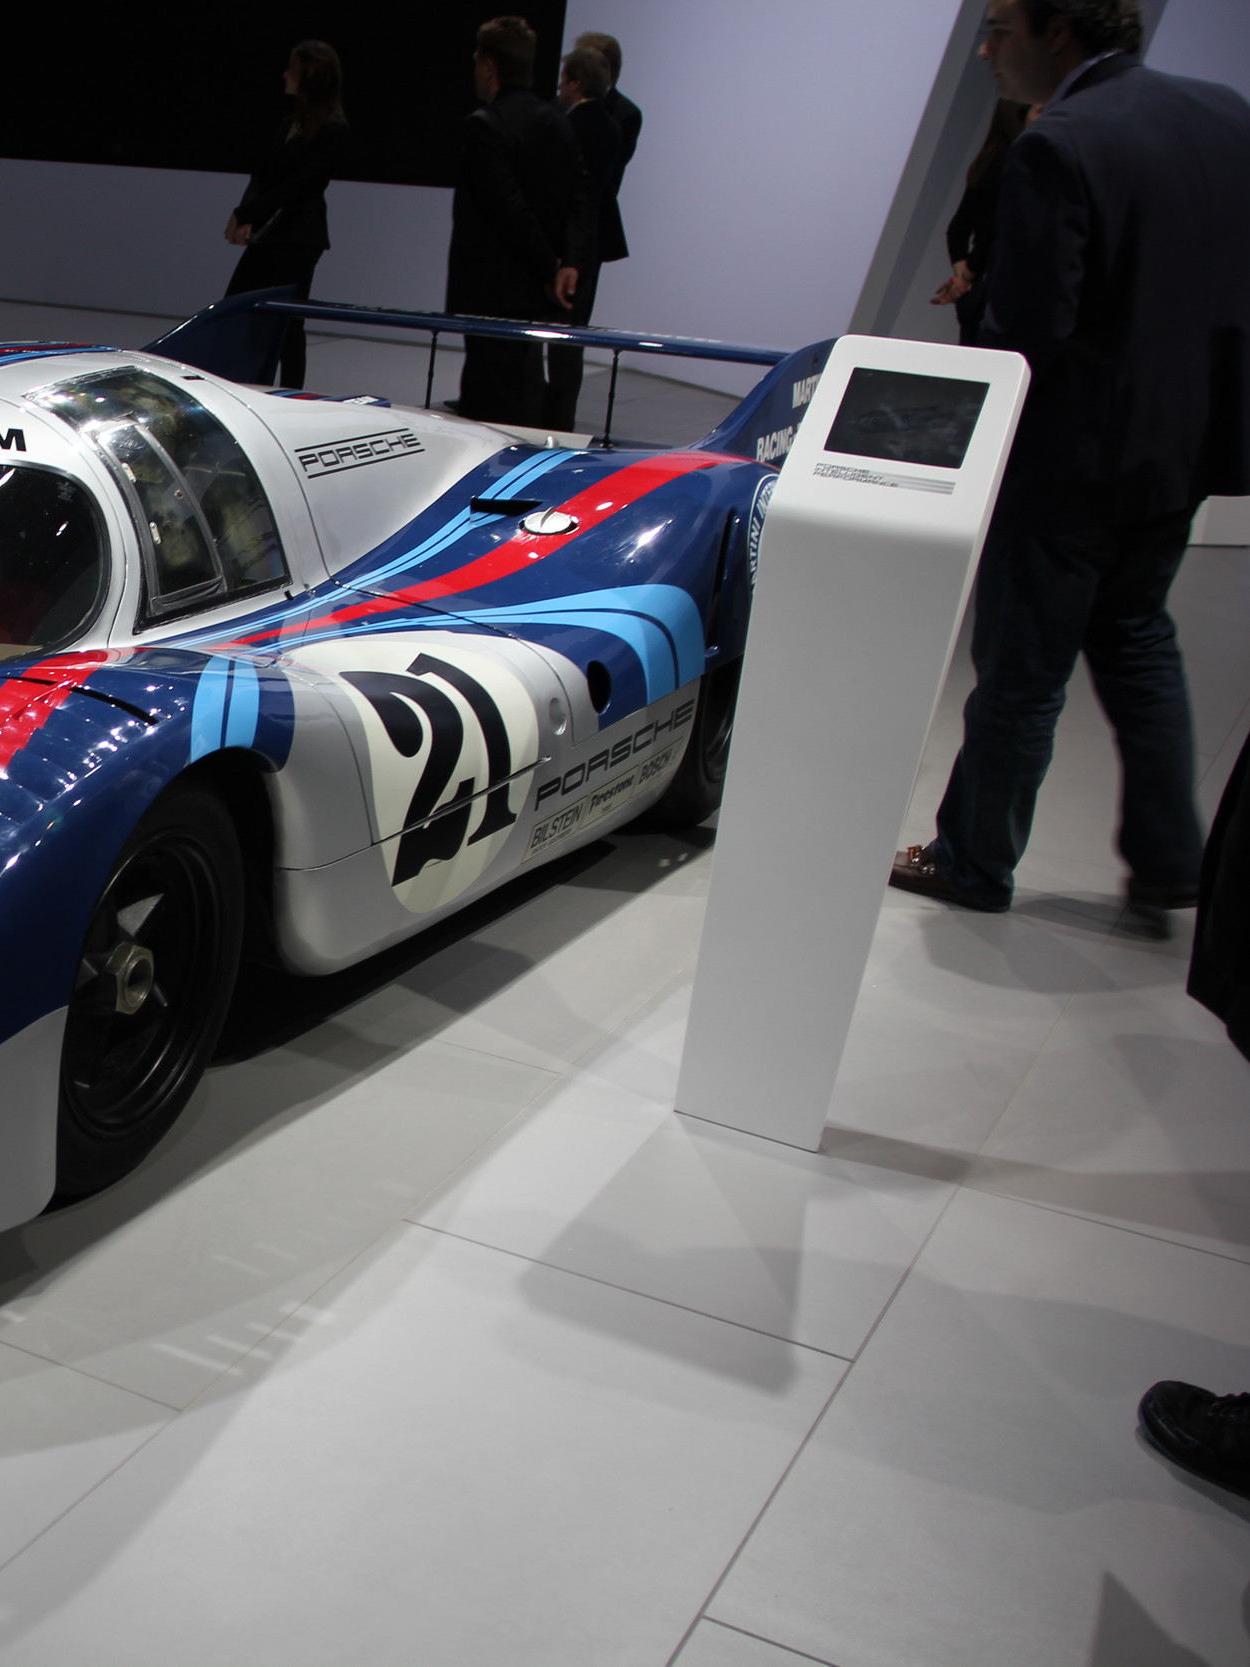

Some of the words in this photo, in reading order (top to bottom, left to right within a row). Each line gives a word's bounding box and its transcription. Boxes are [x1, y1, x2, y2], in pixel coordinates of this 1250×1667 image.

[298, 433, 421, 472] PORSCHE
[339, 652, 517, 888] 21
[530, 804, 584, 849] BILSTEIN
[589, 774, 635, 814] Firestone
[638, 747, 673, 785] BOSCH
[534, 698, 695, 812] PORSCHE
